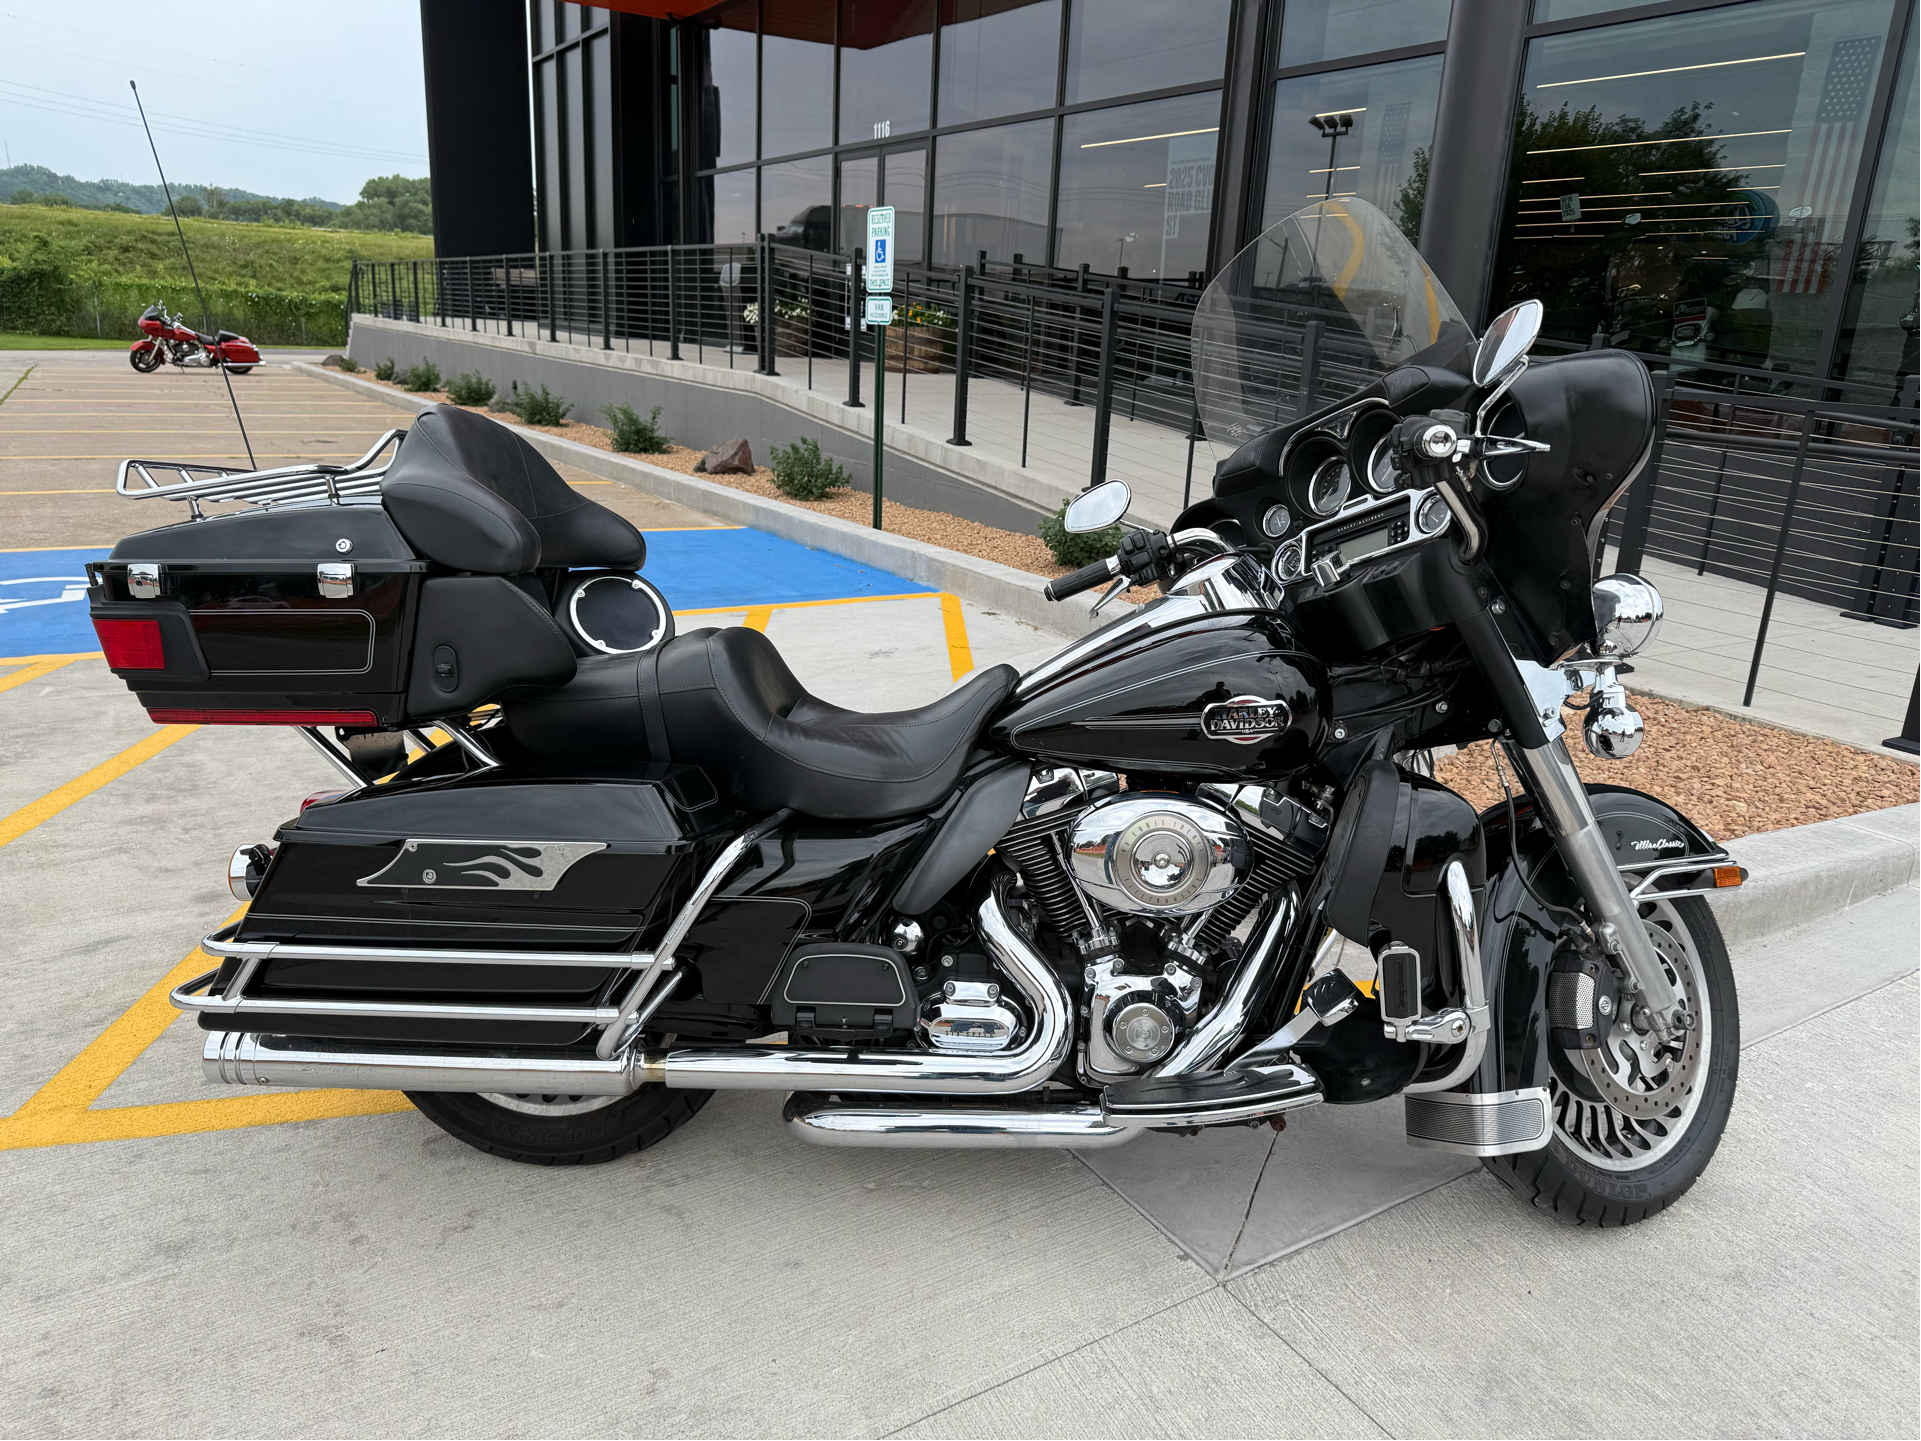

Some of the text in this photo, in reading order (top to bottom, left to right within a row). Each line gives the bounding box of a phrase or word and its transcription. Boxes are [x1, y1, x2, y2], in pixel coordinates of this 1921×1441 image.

[873, 119, 891, 140] 1116
[1169, 164, 1215, 189] 2025 CVO
[1167, 190, 1193, 213] ROAD
[871, 212, 891, 225] RESERVED
[1165, 214, 1178, 237] ST
[871, 225, 890, 238] PARKING
[869, 278, 890, 287] THIS SPACE
[874, 303, 884, 311] VAN
[1210, 716, 1285, 731] DAVIDSON
[514, 1112, 621, 1142] MICHELIN
[1564, 1155, 1649, 1200] DUNLOP
